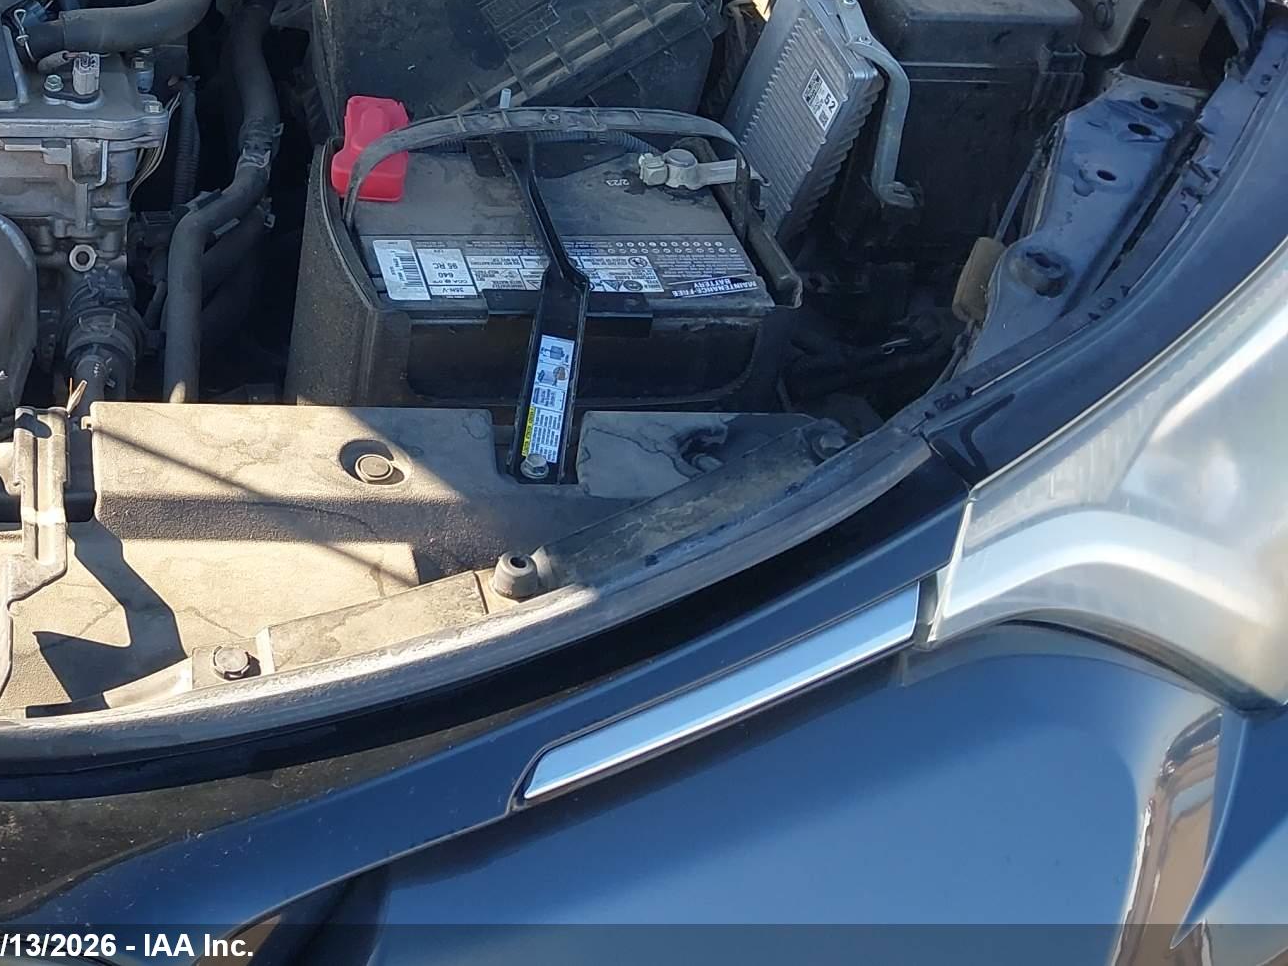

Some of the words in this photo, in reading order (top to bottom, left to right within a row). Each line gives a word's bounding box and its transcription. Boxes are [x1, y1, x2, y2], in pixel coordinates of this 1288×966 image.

[824, 94, 836, 114] 52
[432, 262, 446, 270] RC
[671, 280, 757, 297] MAINTENANCE-FREE
[693, 278, 731, 288] BATTERY
